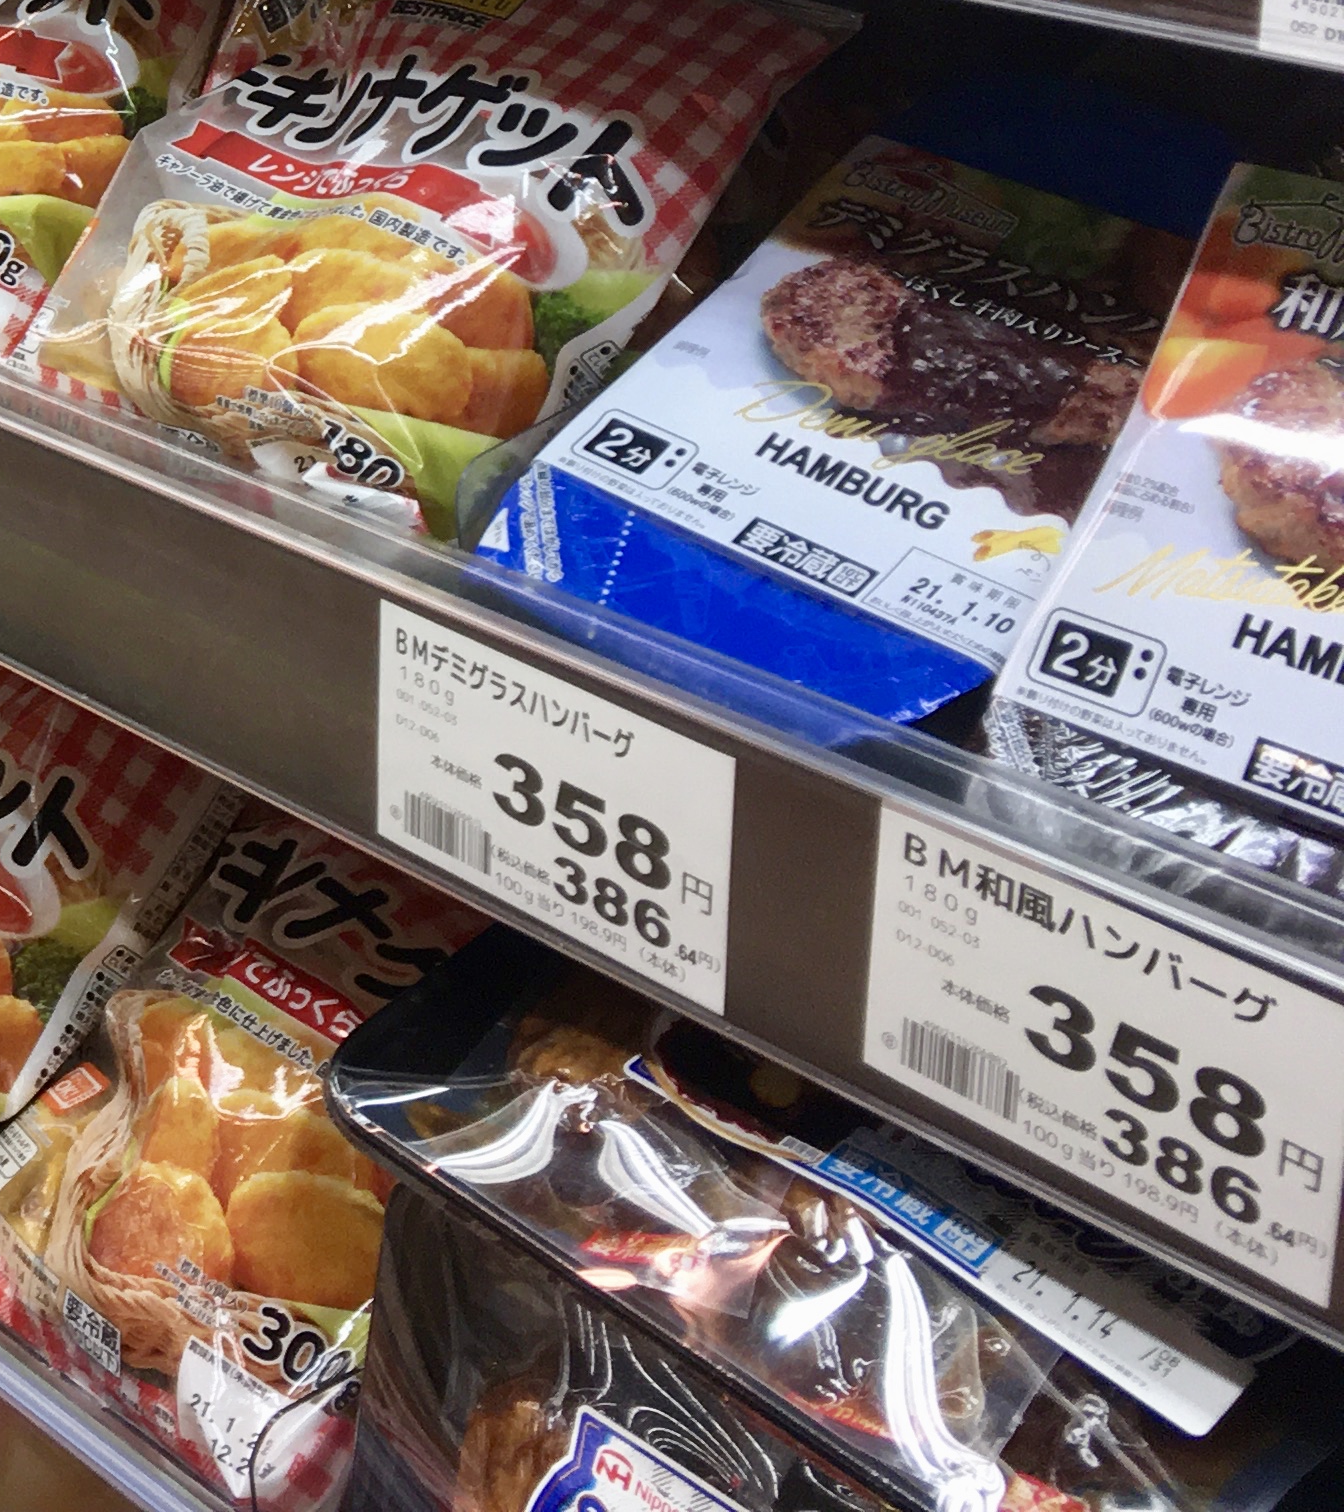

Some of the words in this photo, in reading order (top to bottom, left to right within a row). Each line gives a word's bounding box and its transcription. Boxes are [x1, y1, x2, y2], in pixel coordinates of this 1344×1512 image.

[594, 426, 655, 476] 2分
[692, 461, 759, 496] 電子レンジ
[755, 431, 951, 532] HAMBURG
[739, 520, 834, 579] 要冷蔵
[399, 665, 456, 707] 180g
[1044, 629, 1121, 695] 2分
[1168, 664, 1251, 708] 電子レンジ
[1179, 695, 1217, 722] 専用
[904, 874, 981, 926] 180g
